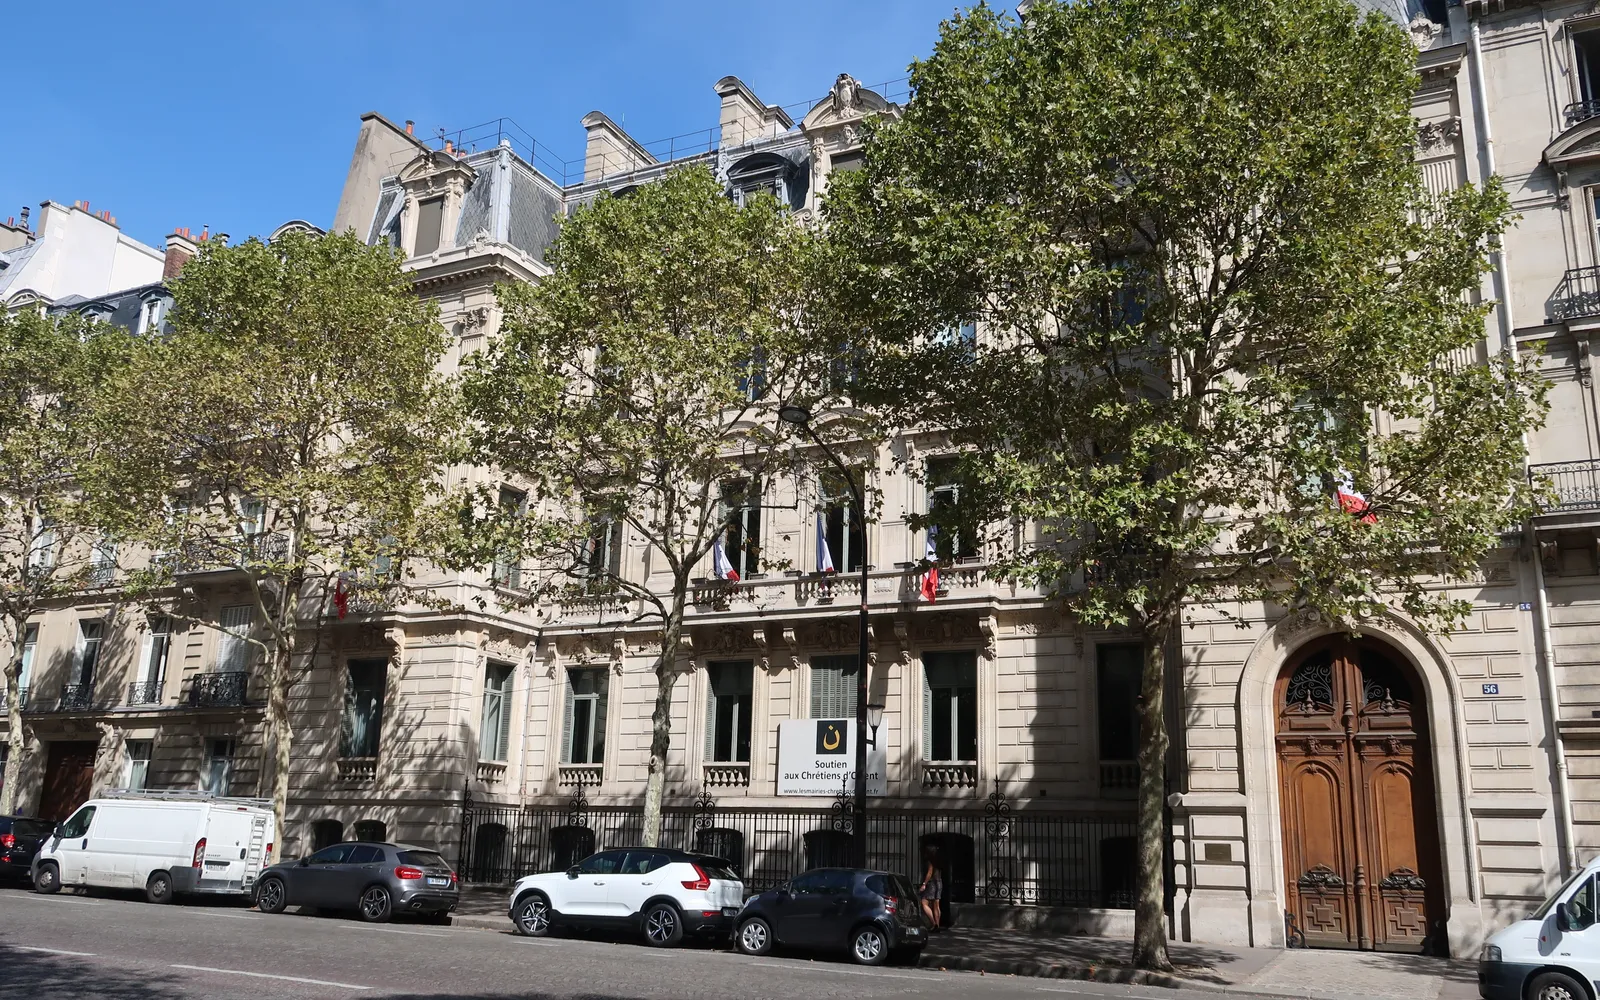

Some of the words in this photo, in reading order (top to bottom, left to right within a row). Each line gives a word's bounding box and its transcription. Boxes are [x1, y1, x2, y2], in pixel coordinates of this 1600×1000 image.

[1484, 685, 1496, 694] 56
[815, 760, 847, 769] Soutien
[801, 771, 841, 780] Chrétiens
[843, 771, 879, 780] d'Oent
